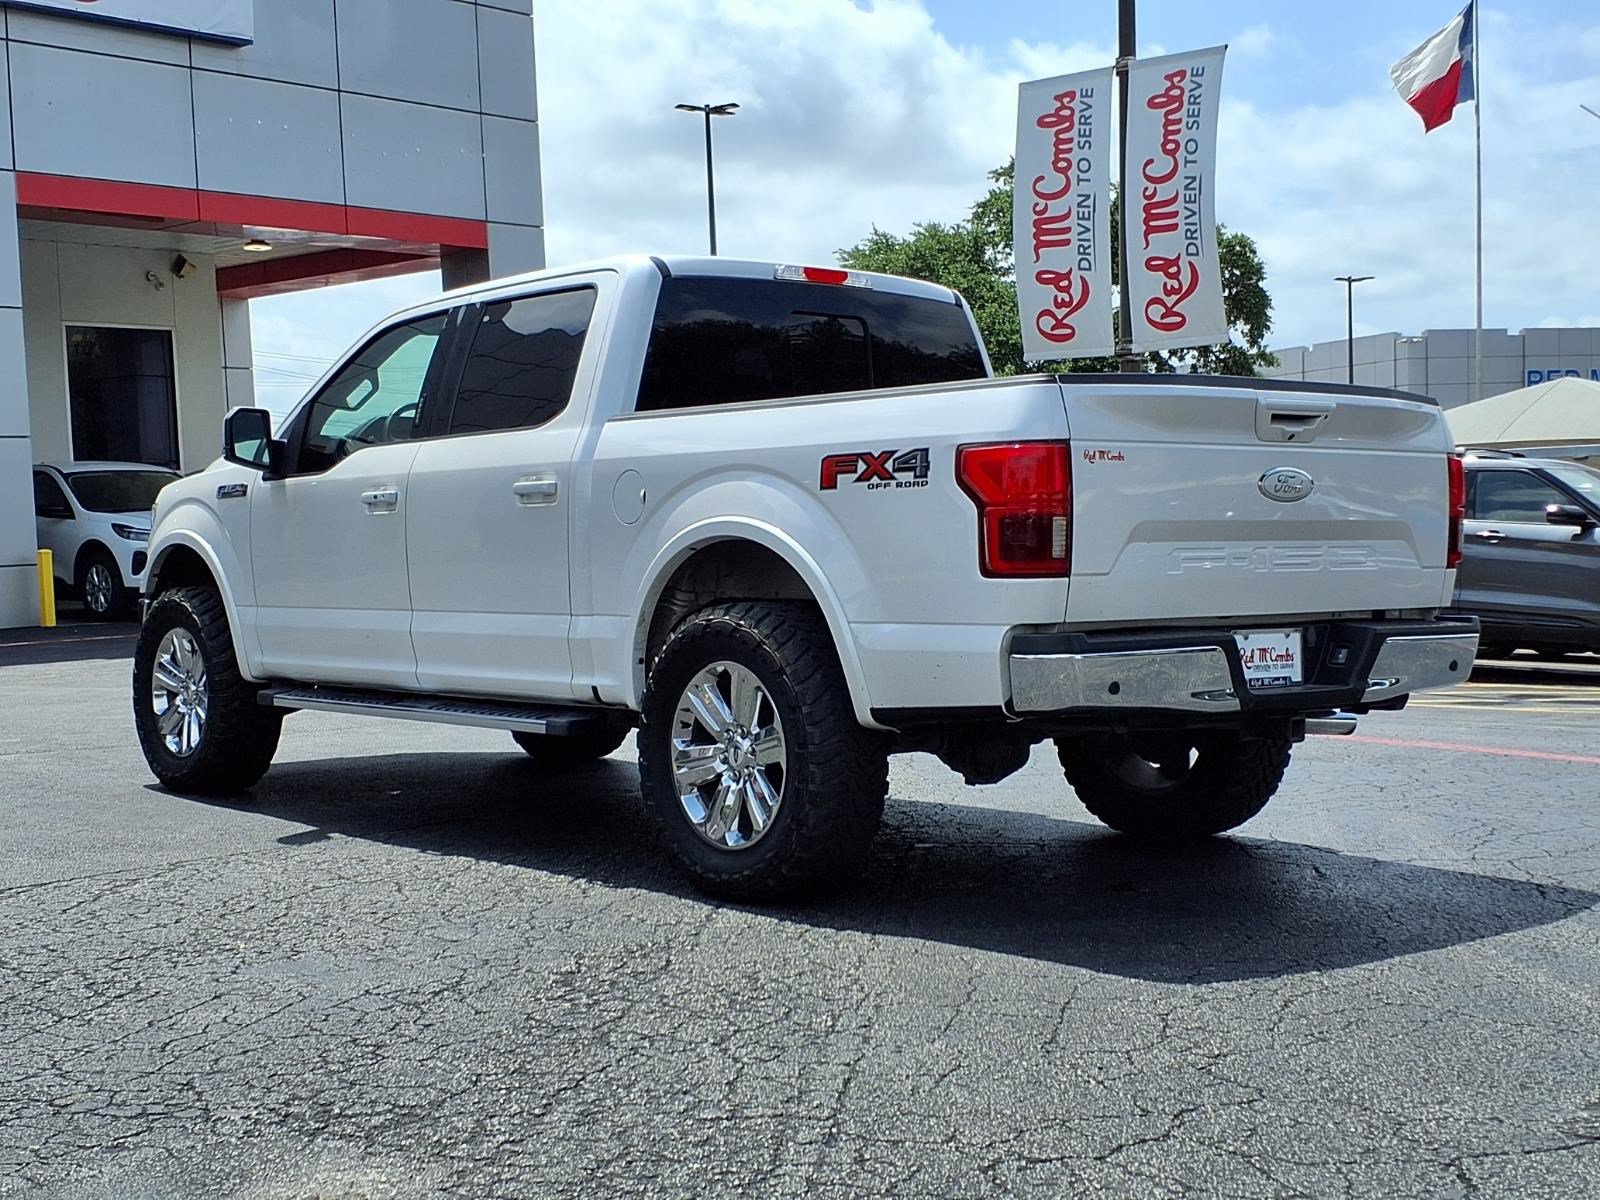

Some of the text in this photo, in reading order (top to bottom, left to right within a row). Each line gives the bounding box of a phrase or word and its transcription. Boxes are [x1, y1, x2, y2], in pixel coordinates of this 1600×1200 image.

[1183, 66, 1205, 257] DRIVEN TO SERVE
[1076, 88, 1094, 272] DRIVEN TO SERVE
[1032, 90, 1090, 343] Red McCombs
[1142, 68, 1200, 332] Red McCombs
[819, 447, 930, 491] FX4
[1083, 449, 1096, 464] Red
[867, 480, 929, 490] OFF ROAD
[1273, 473, 1304, 494] Ford
[1167, 545, 1380, 574] F-150
[1239, 646, 1294, 669] Red McCombs
